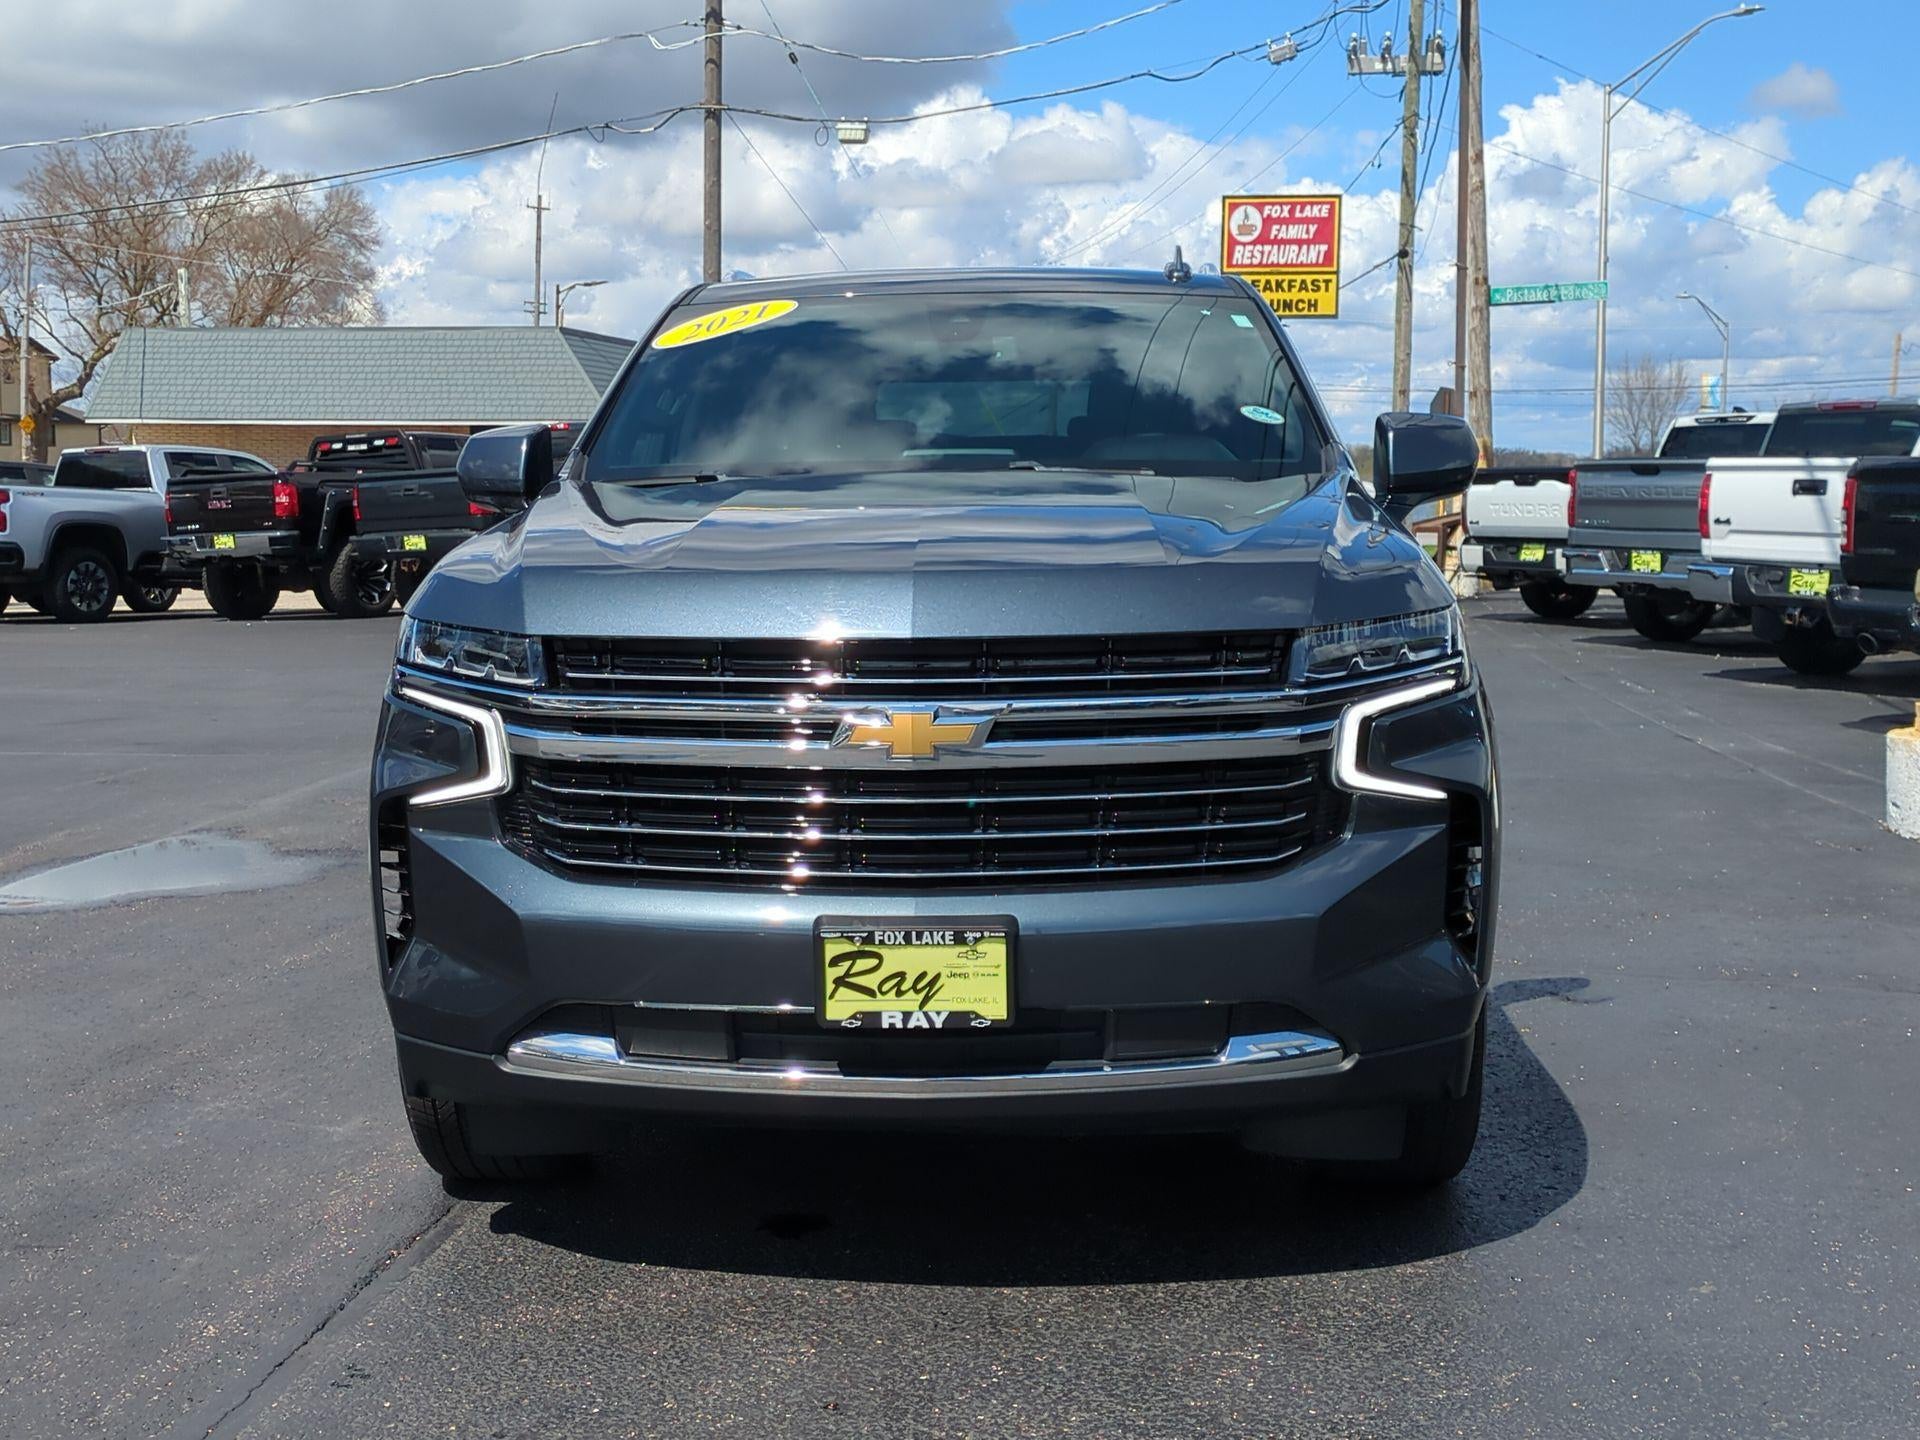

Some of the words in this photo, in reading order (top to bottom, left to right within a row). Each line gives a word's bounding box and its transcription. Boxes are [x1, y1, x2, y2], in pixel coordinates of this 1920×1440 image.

[1263, 204, 1291, 218] FOX
[1295, 204, 1331, 218] LAKE
[1270, 224, 1318, 240] FAMILY
[1232, 244, 1328, 265] RESTAURANT
[1251, 279, 1332, 293] EAKFAST
[1270, 299, 1318, 313] UNCH
[682, 304, 769, 342] 2021
[1581, 485, 1700, 499] CHEVROLE
[1489, 503, 1561, 517] TUNDRA
[1792, 574, 1815, 589] Ray
[874, 931, 905, 945] FOX
[912, 931, 954, 945] LAKE
[828, 949, 945, 1010] Ray
[946, 971, 969, 979] Jeep
[951, 996, 967, 1004] FOX
[881, 1011, 950, 1029] RAY
